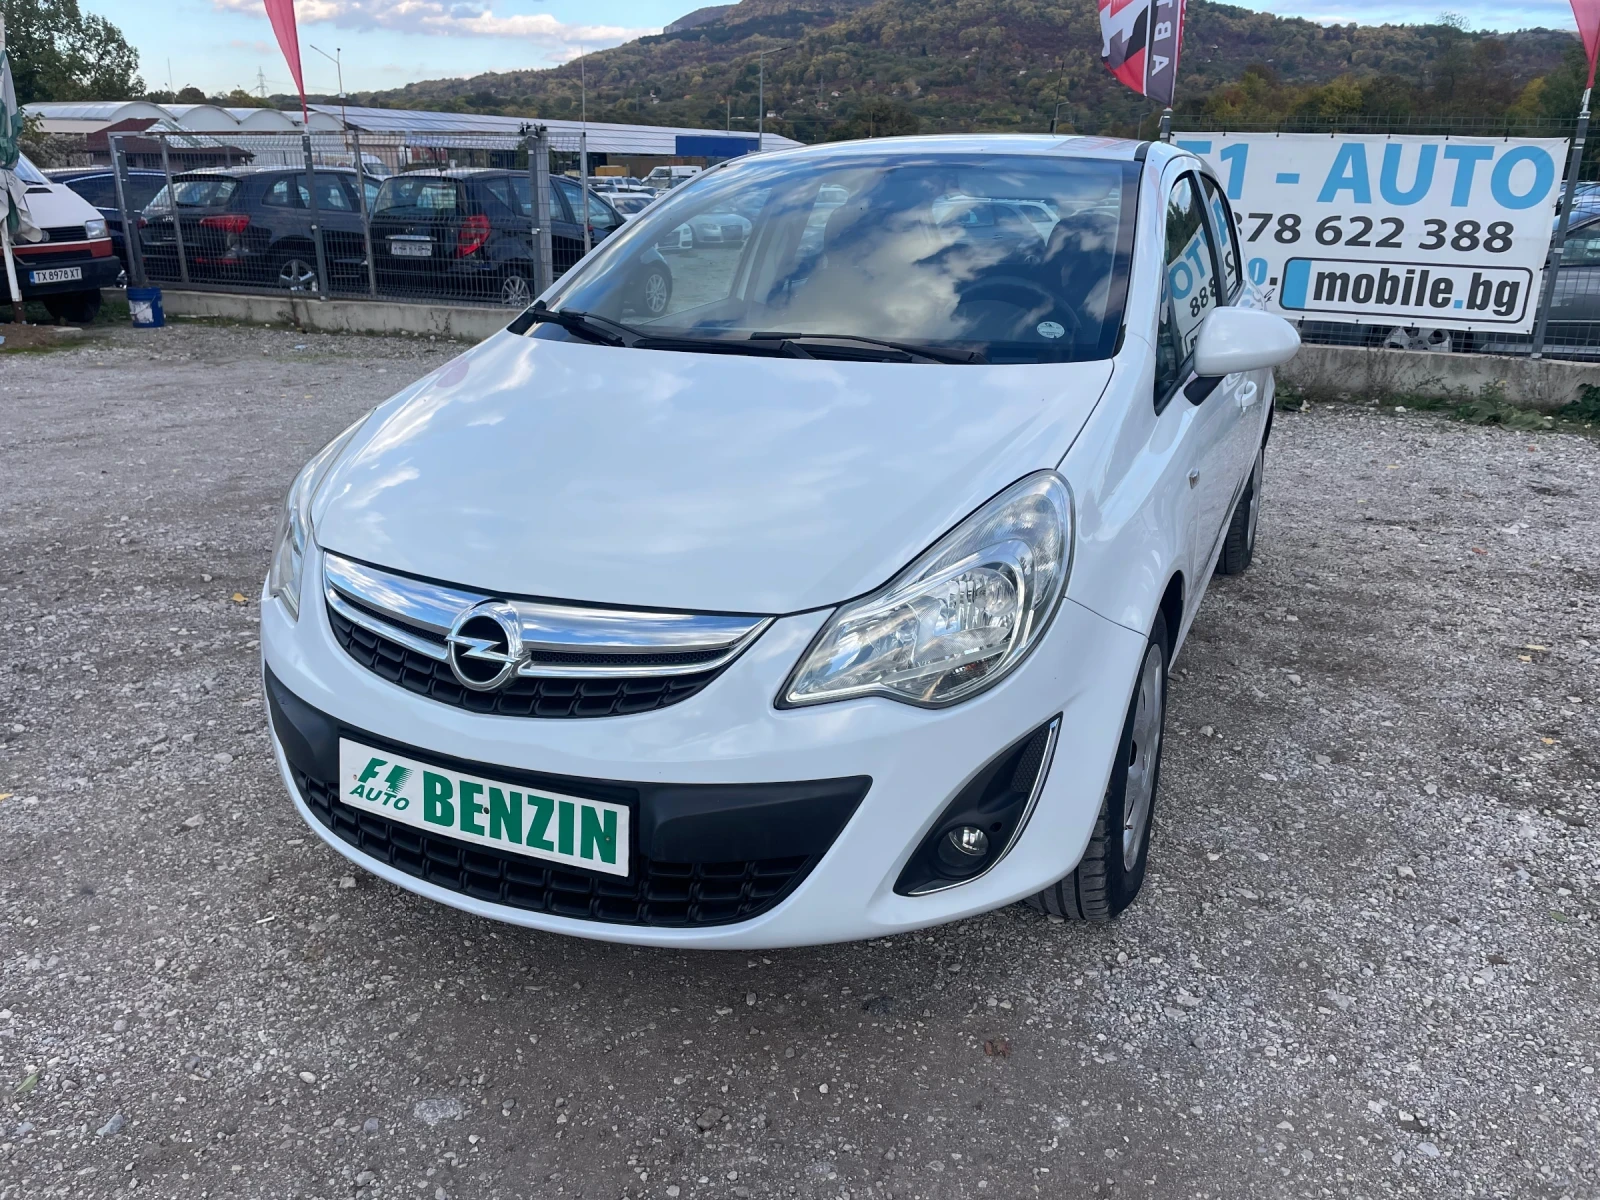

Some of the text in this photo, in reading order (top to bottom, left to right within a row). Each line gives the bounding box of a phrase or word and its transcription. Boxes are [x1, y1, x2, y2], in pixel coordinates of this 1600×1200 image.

[1317, 142, 1555, 210] AUTO
[1315, 215, 1405, 249] 622
[1418, 218, 1514, 253] 388
[36, 268, 80, 282] TX 8978 XT
[1312, 267, 1520, 316] mobile.bg
[349, 783, 410, 811] AUTO
[423, 770, 618, 865] BENZIN
